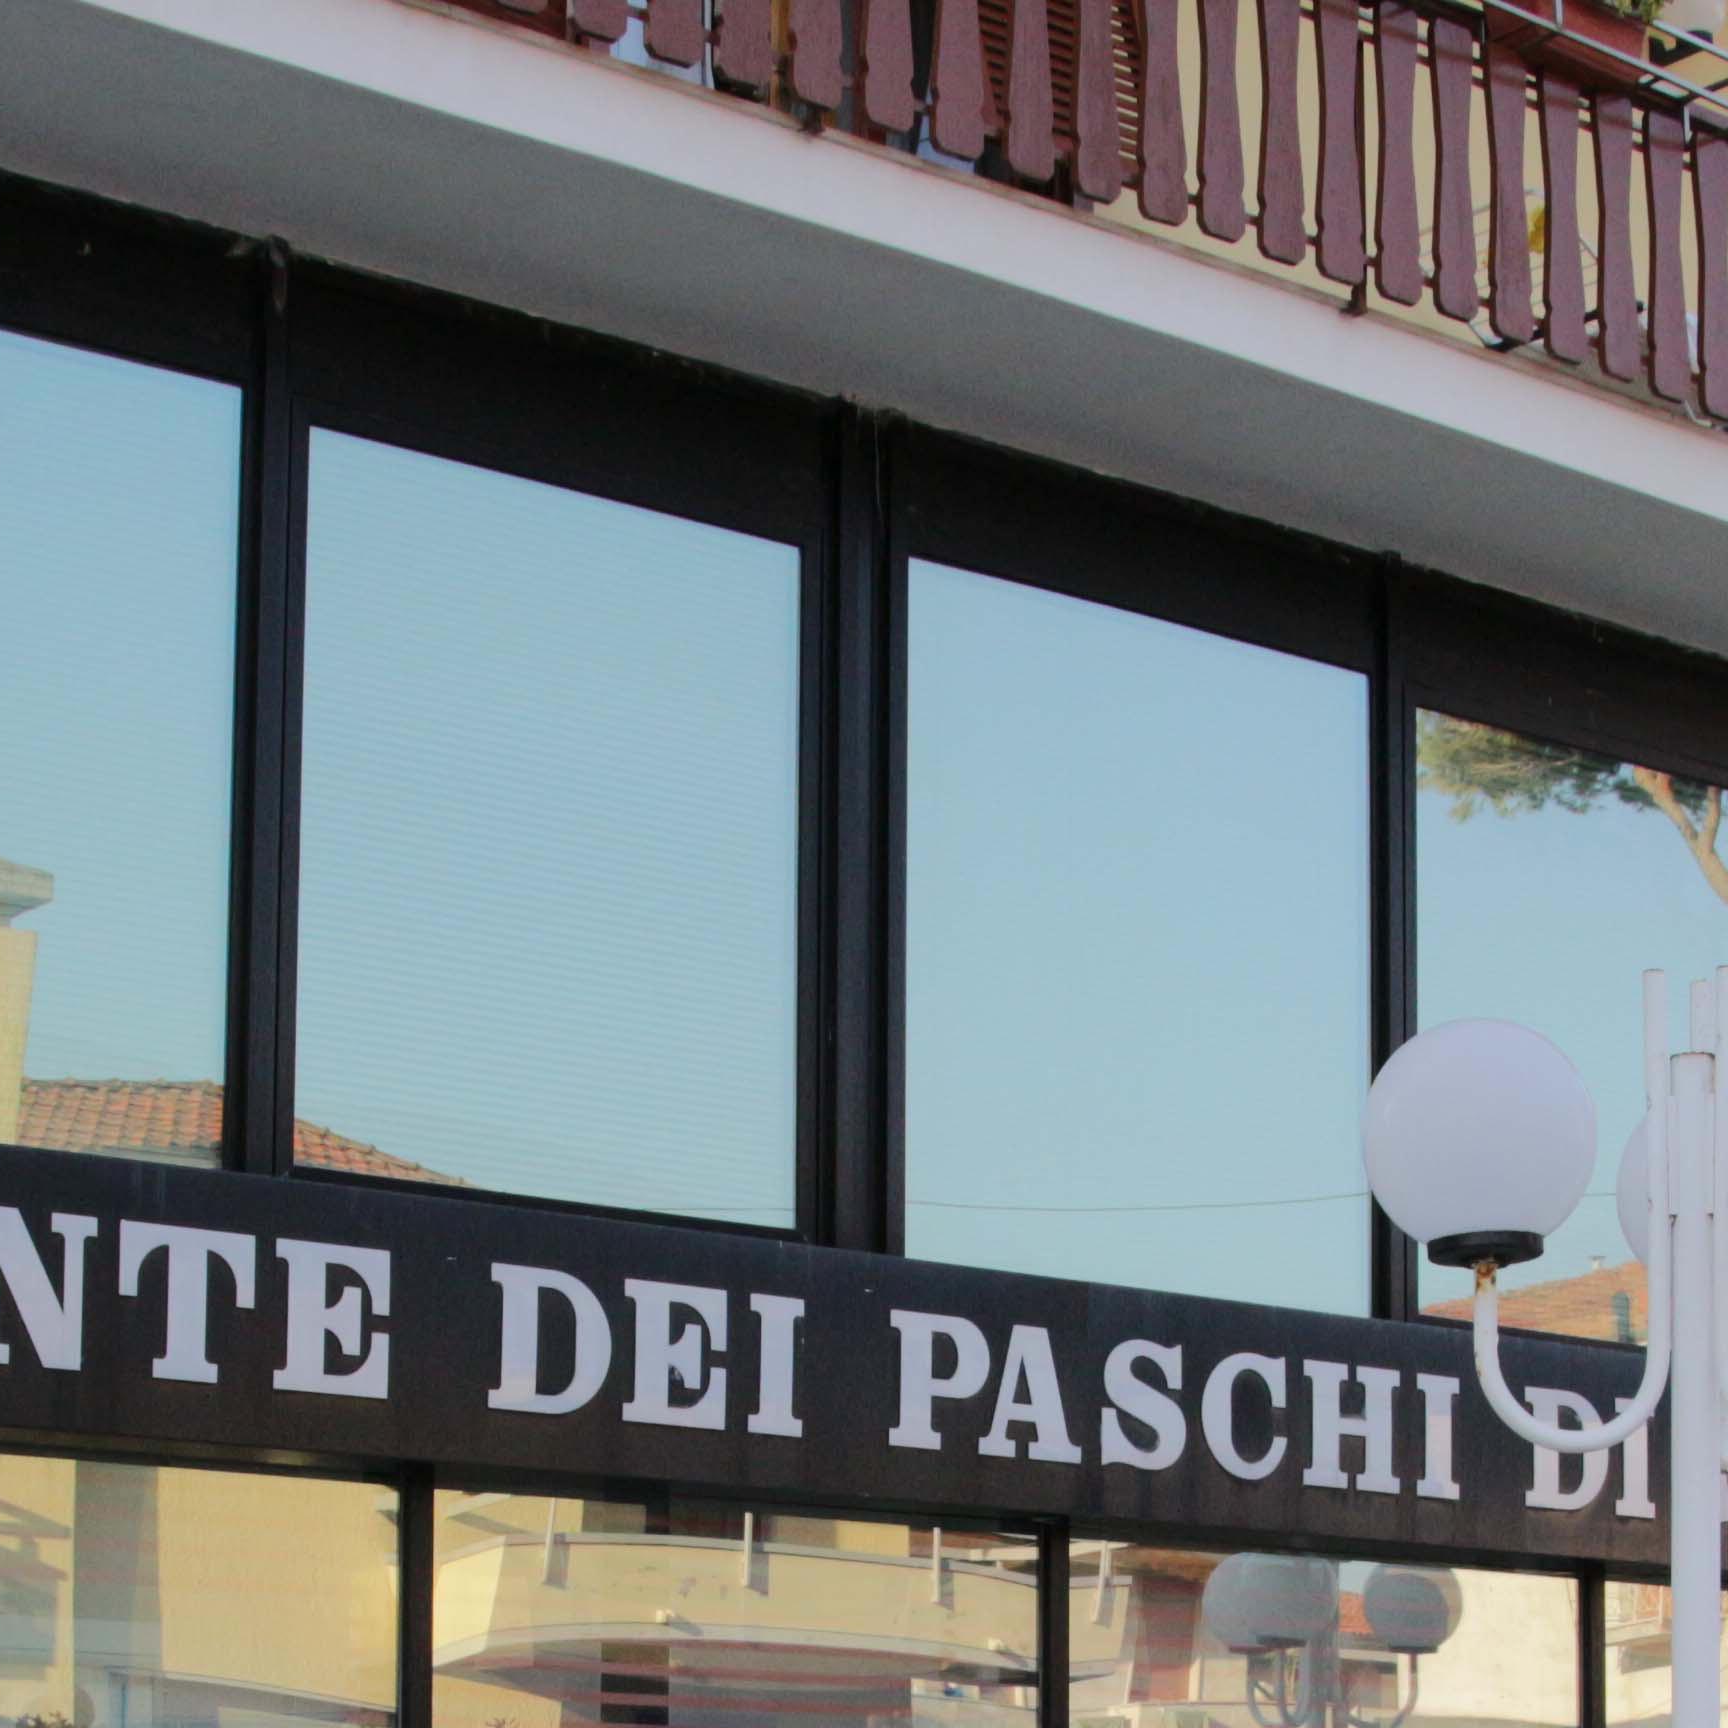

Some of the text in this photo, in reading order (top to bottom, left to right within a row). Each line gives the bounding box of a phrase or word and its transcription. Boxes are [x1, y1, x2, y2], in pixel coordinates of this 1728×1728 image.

[486, 1261, 806, 1439] DEI
[887, 1308, 1461, 1501] PASCHI
[1524, 1386, 1656, 1519] DI
